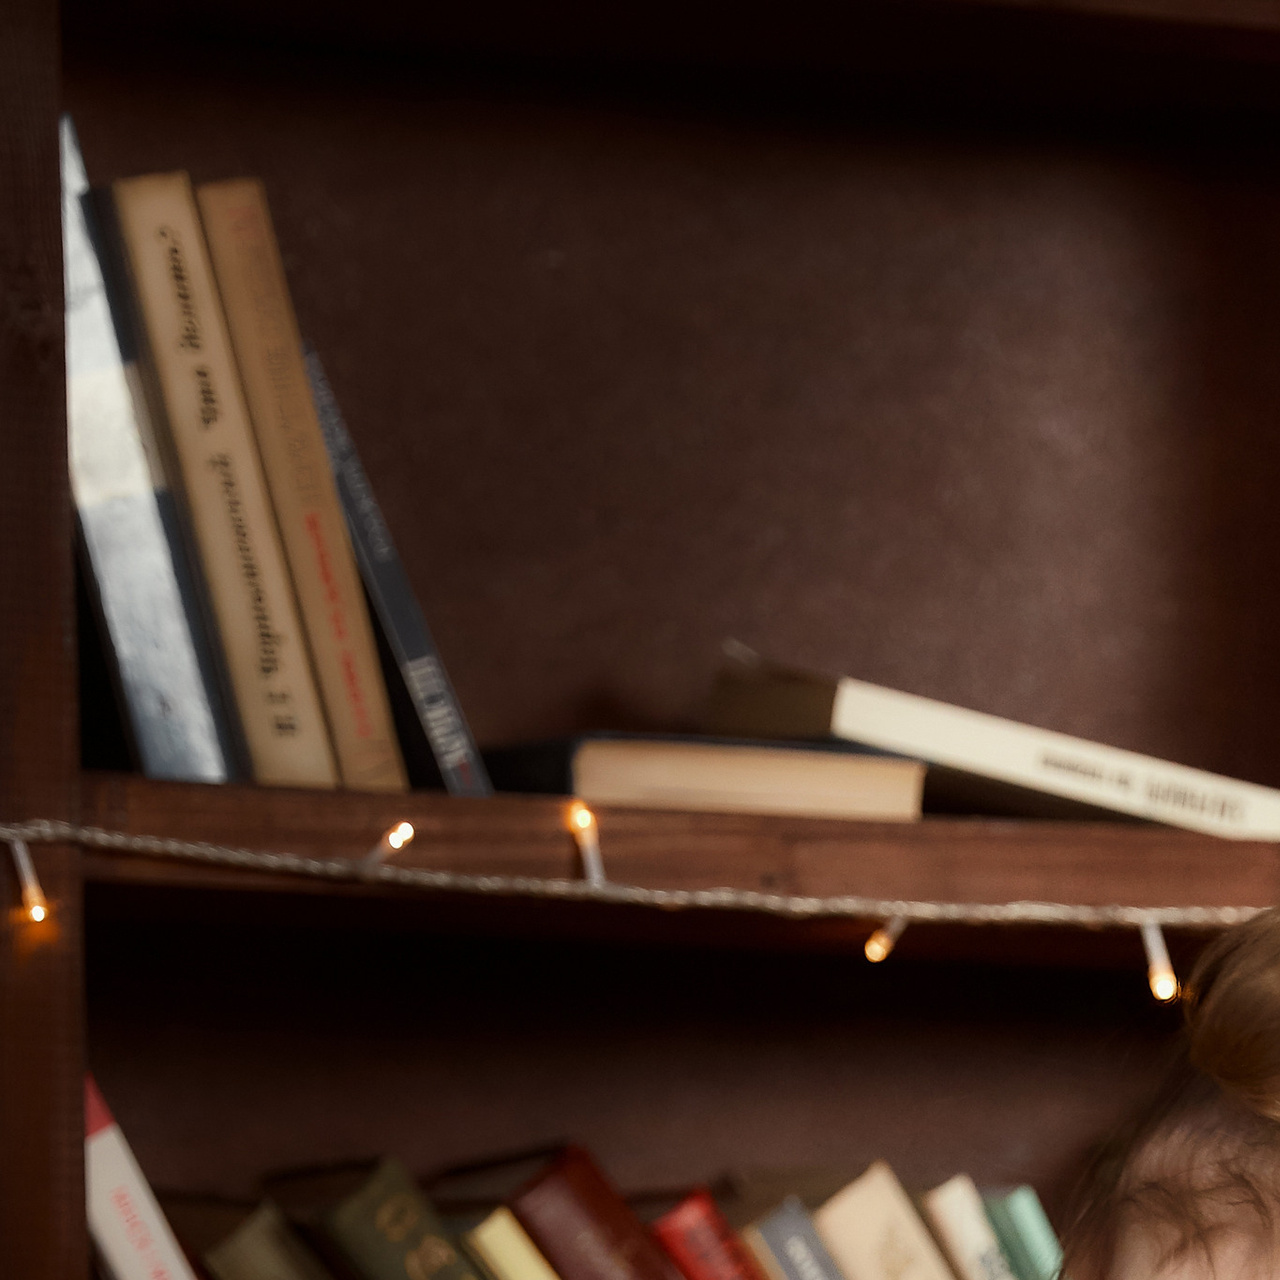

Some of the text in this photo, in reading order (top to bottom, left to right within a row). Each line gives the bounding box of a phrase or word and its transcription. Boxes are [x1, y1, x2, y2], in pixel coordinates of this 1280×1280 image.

[157, 228, 204, 352] делать?
[190, 365, 221, 430] Что
[209, 453, 284, 679] Чернышевский
